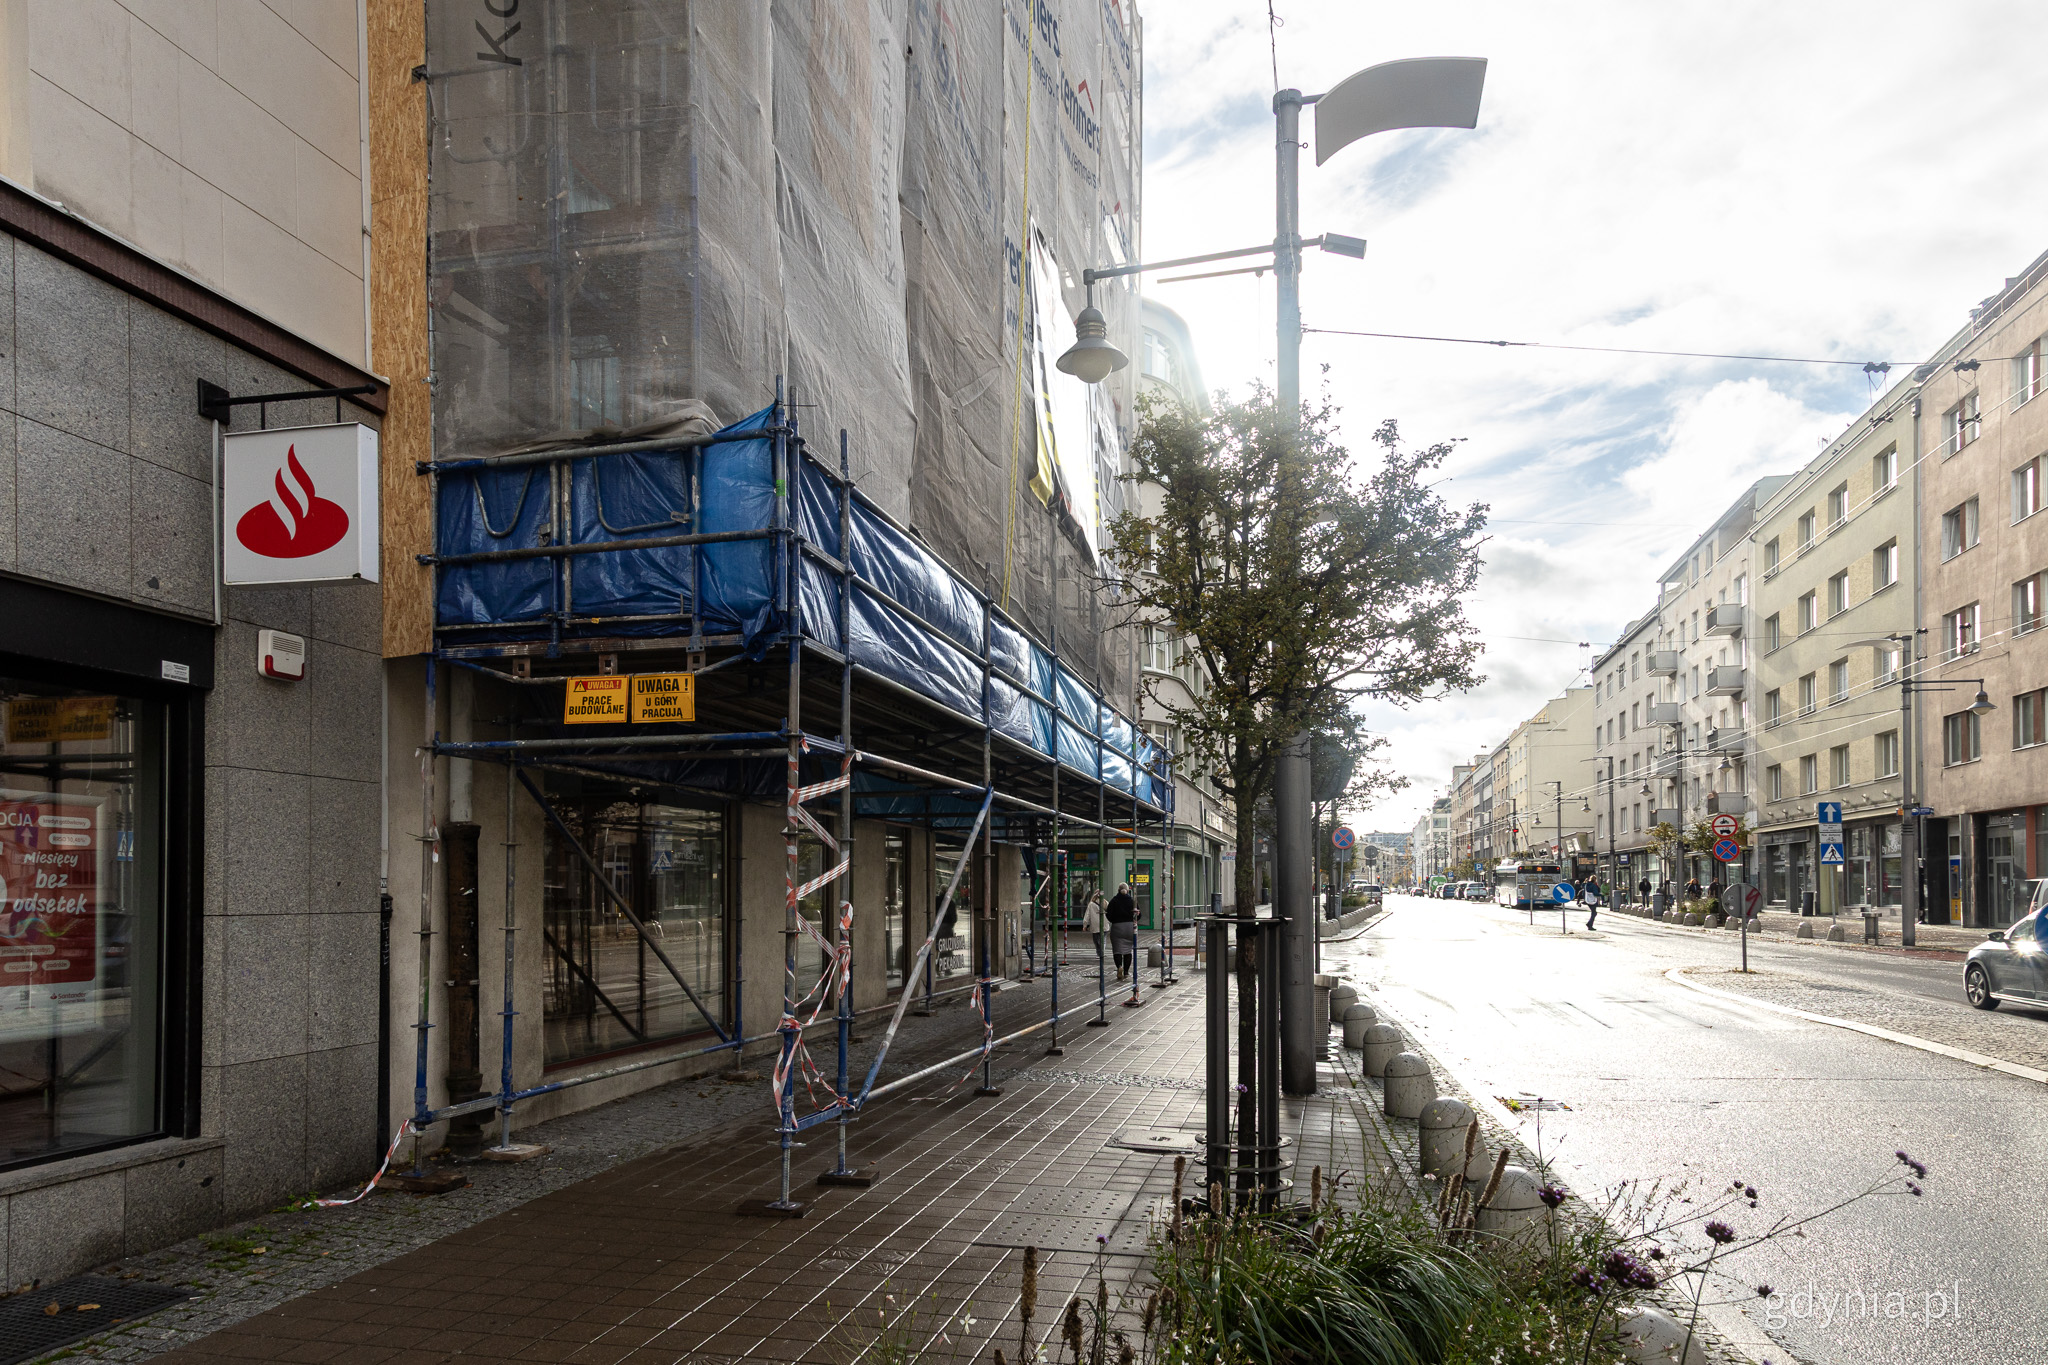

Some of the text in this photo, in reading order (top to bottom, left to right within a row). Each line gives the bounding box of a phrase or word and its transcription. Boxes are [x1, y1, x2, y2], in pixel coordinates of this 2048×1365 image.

[1060, 66, 1100, 156] remmers
[587, 681, 614, 690] UWAGA
[637, 678, 689, 693] UWAGA !
[582, 695, 612, 705] PRACE
[645, 694, 678, 707] U GÓRY
[568, 704, 624, 716] BUDOWLANE
[642, 707, 683, 719] PRACUJĄ
[35, 869, 68, 889] bez
[13, 893, 87, 915] odsetek
[938, 954, 965, 971] PIEKARNIA
